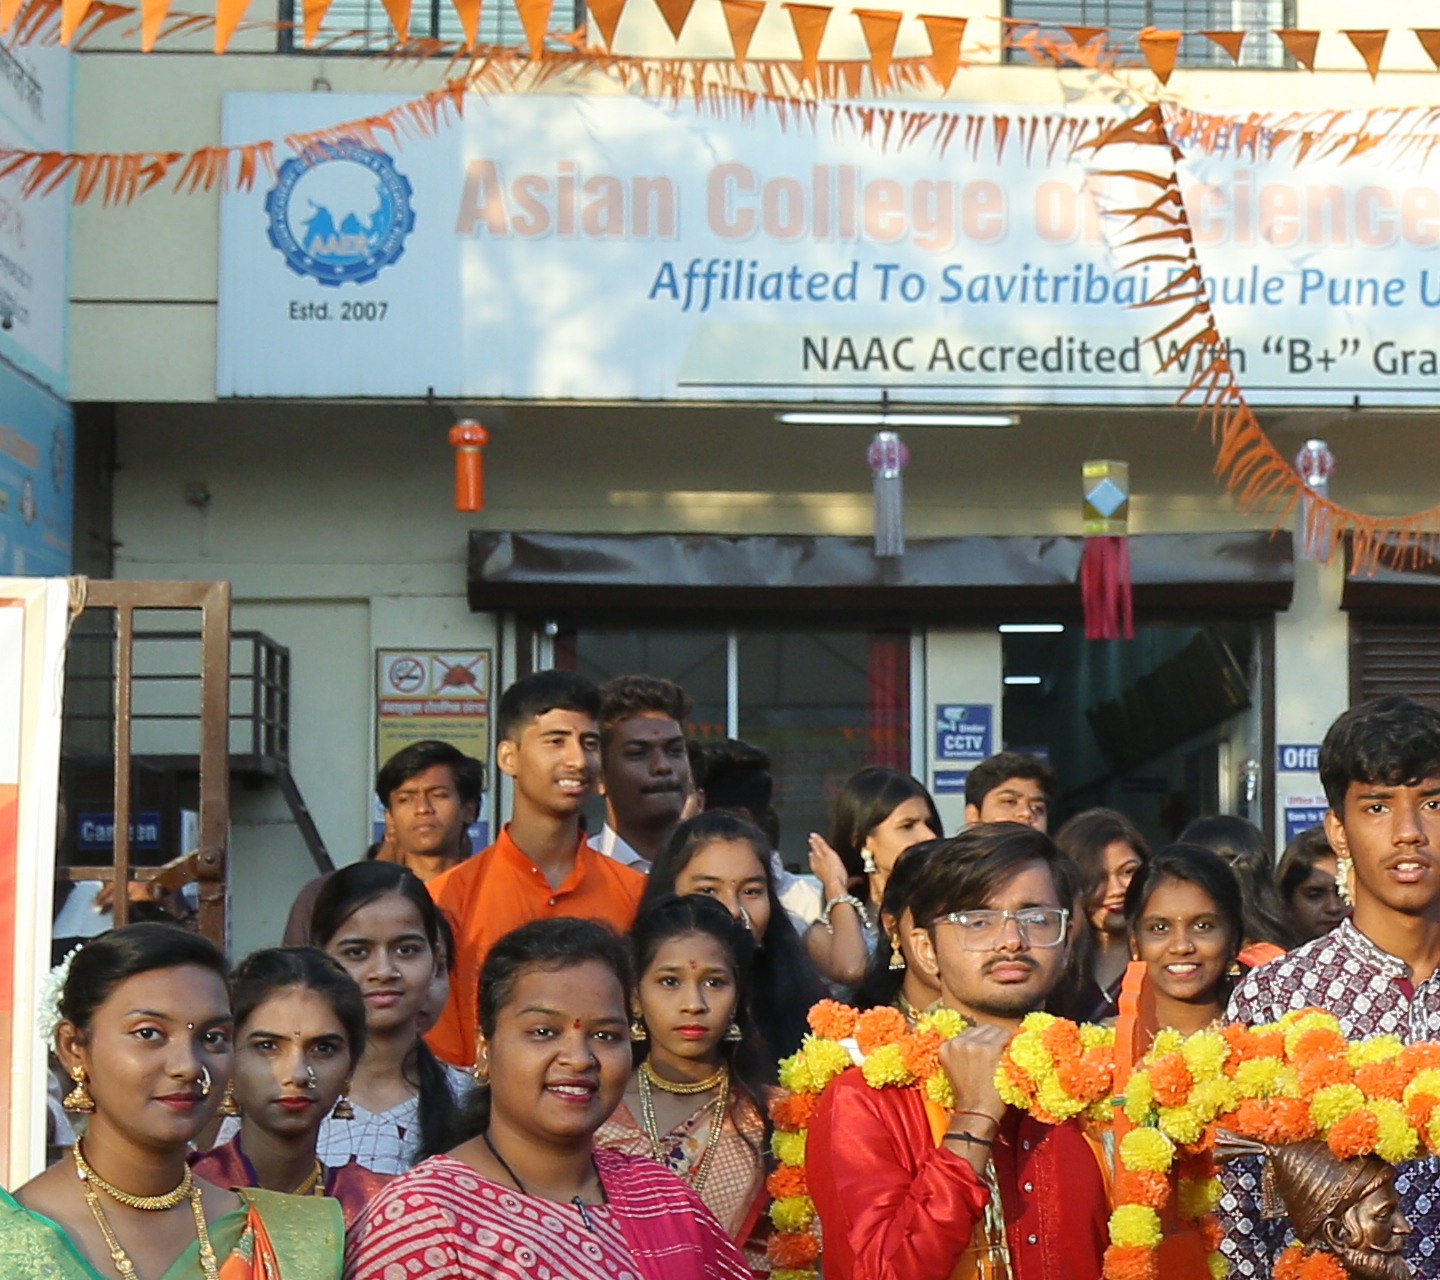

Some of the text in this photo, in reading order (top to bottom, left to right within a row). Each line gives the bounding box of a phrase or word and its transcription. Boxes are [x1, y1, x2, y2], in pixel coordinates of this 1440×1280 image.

[455, 159, 677, 240] Asian
[705, 161, 1006, 249] College
[649, 259, 861, 312] Affiliated
[873, 262, 928, 304] To
[940, 261, 1151, 307] Savitribai
[1298, 265, 1407, 308] Pune
[340, 301, 389, 321] 2007
[801, 336, 916, 373] NAAC
[927, 334, 1142, 375] Accredited
[944, 735, 984, 751] CCTV
